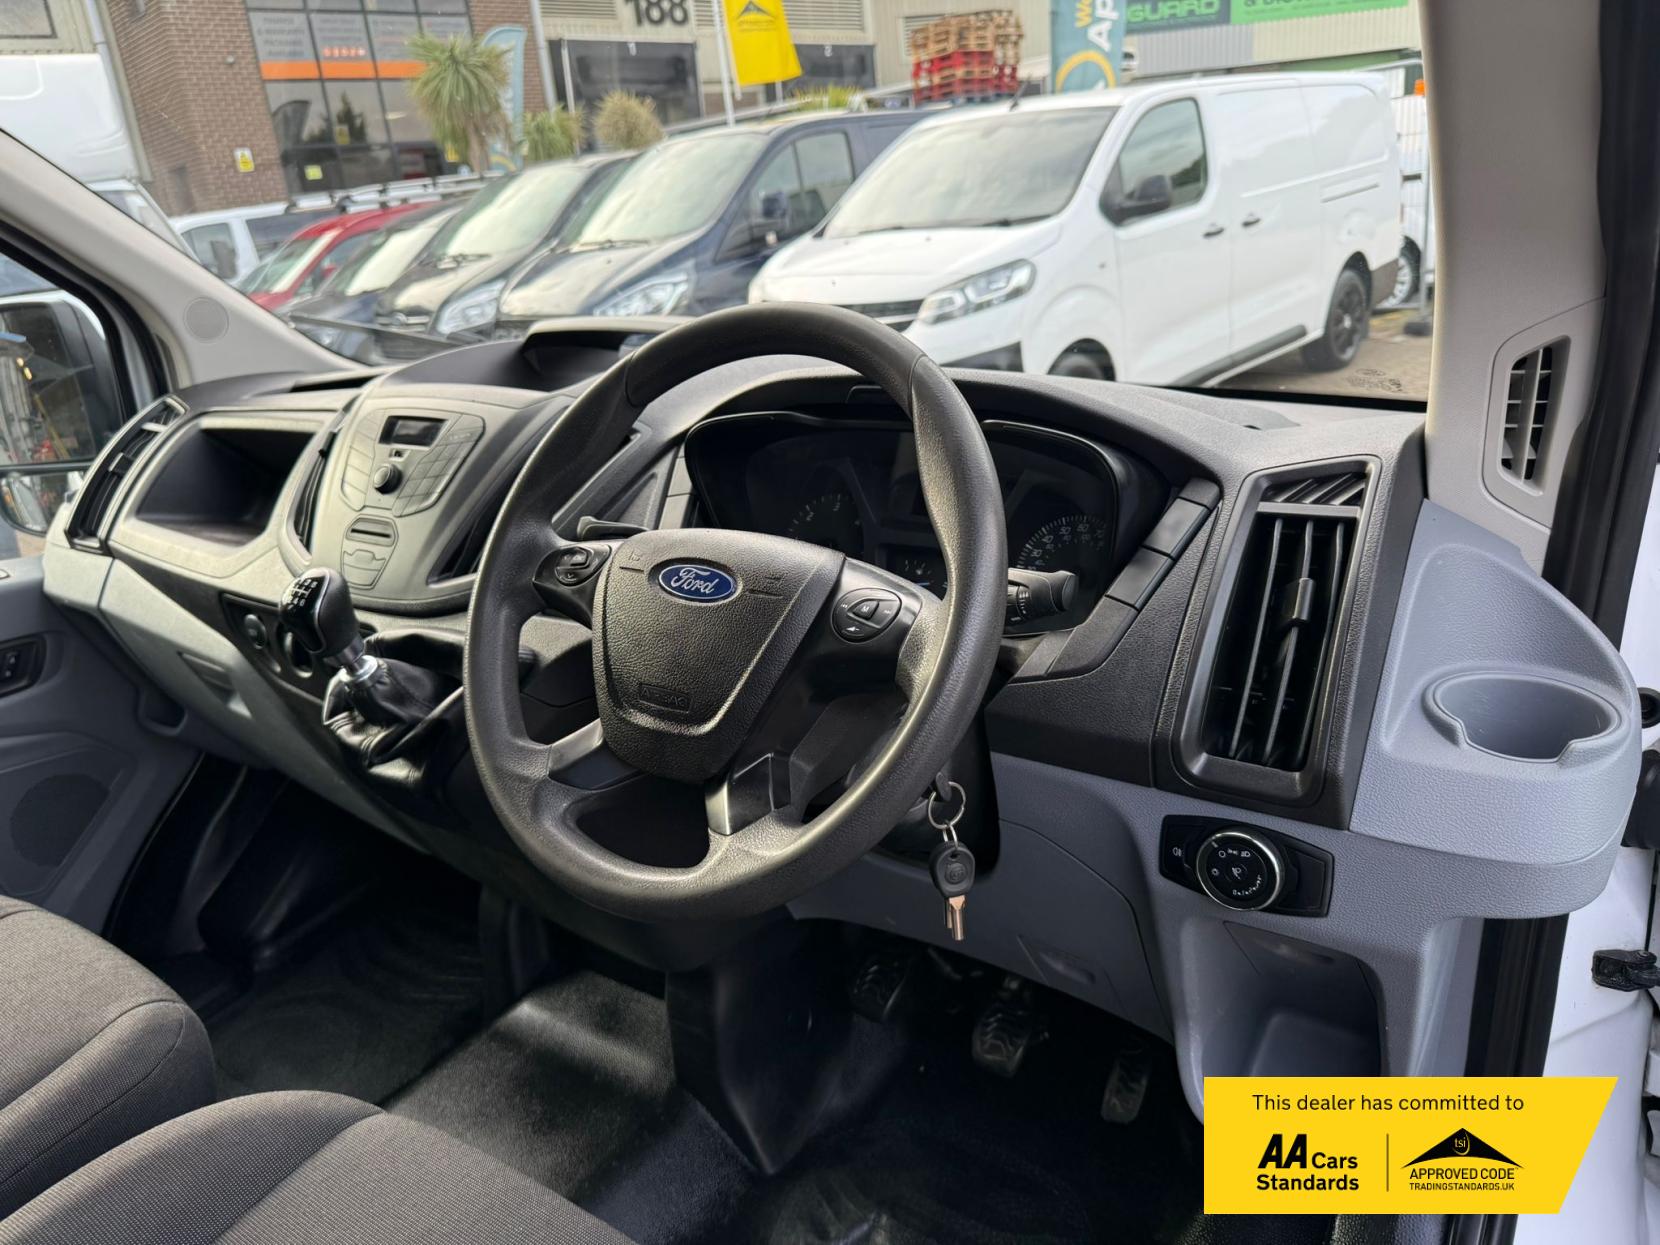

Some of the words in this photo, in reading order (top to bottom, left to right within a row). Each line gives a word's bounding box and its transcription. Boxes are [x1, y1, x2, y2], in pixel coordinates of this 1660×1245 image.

[624, 0, 689, 26] 188
[1128, 0, 1221, 22] GUARD
[670, 567, 719, 594] Ford
